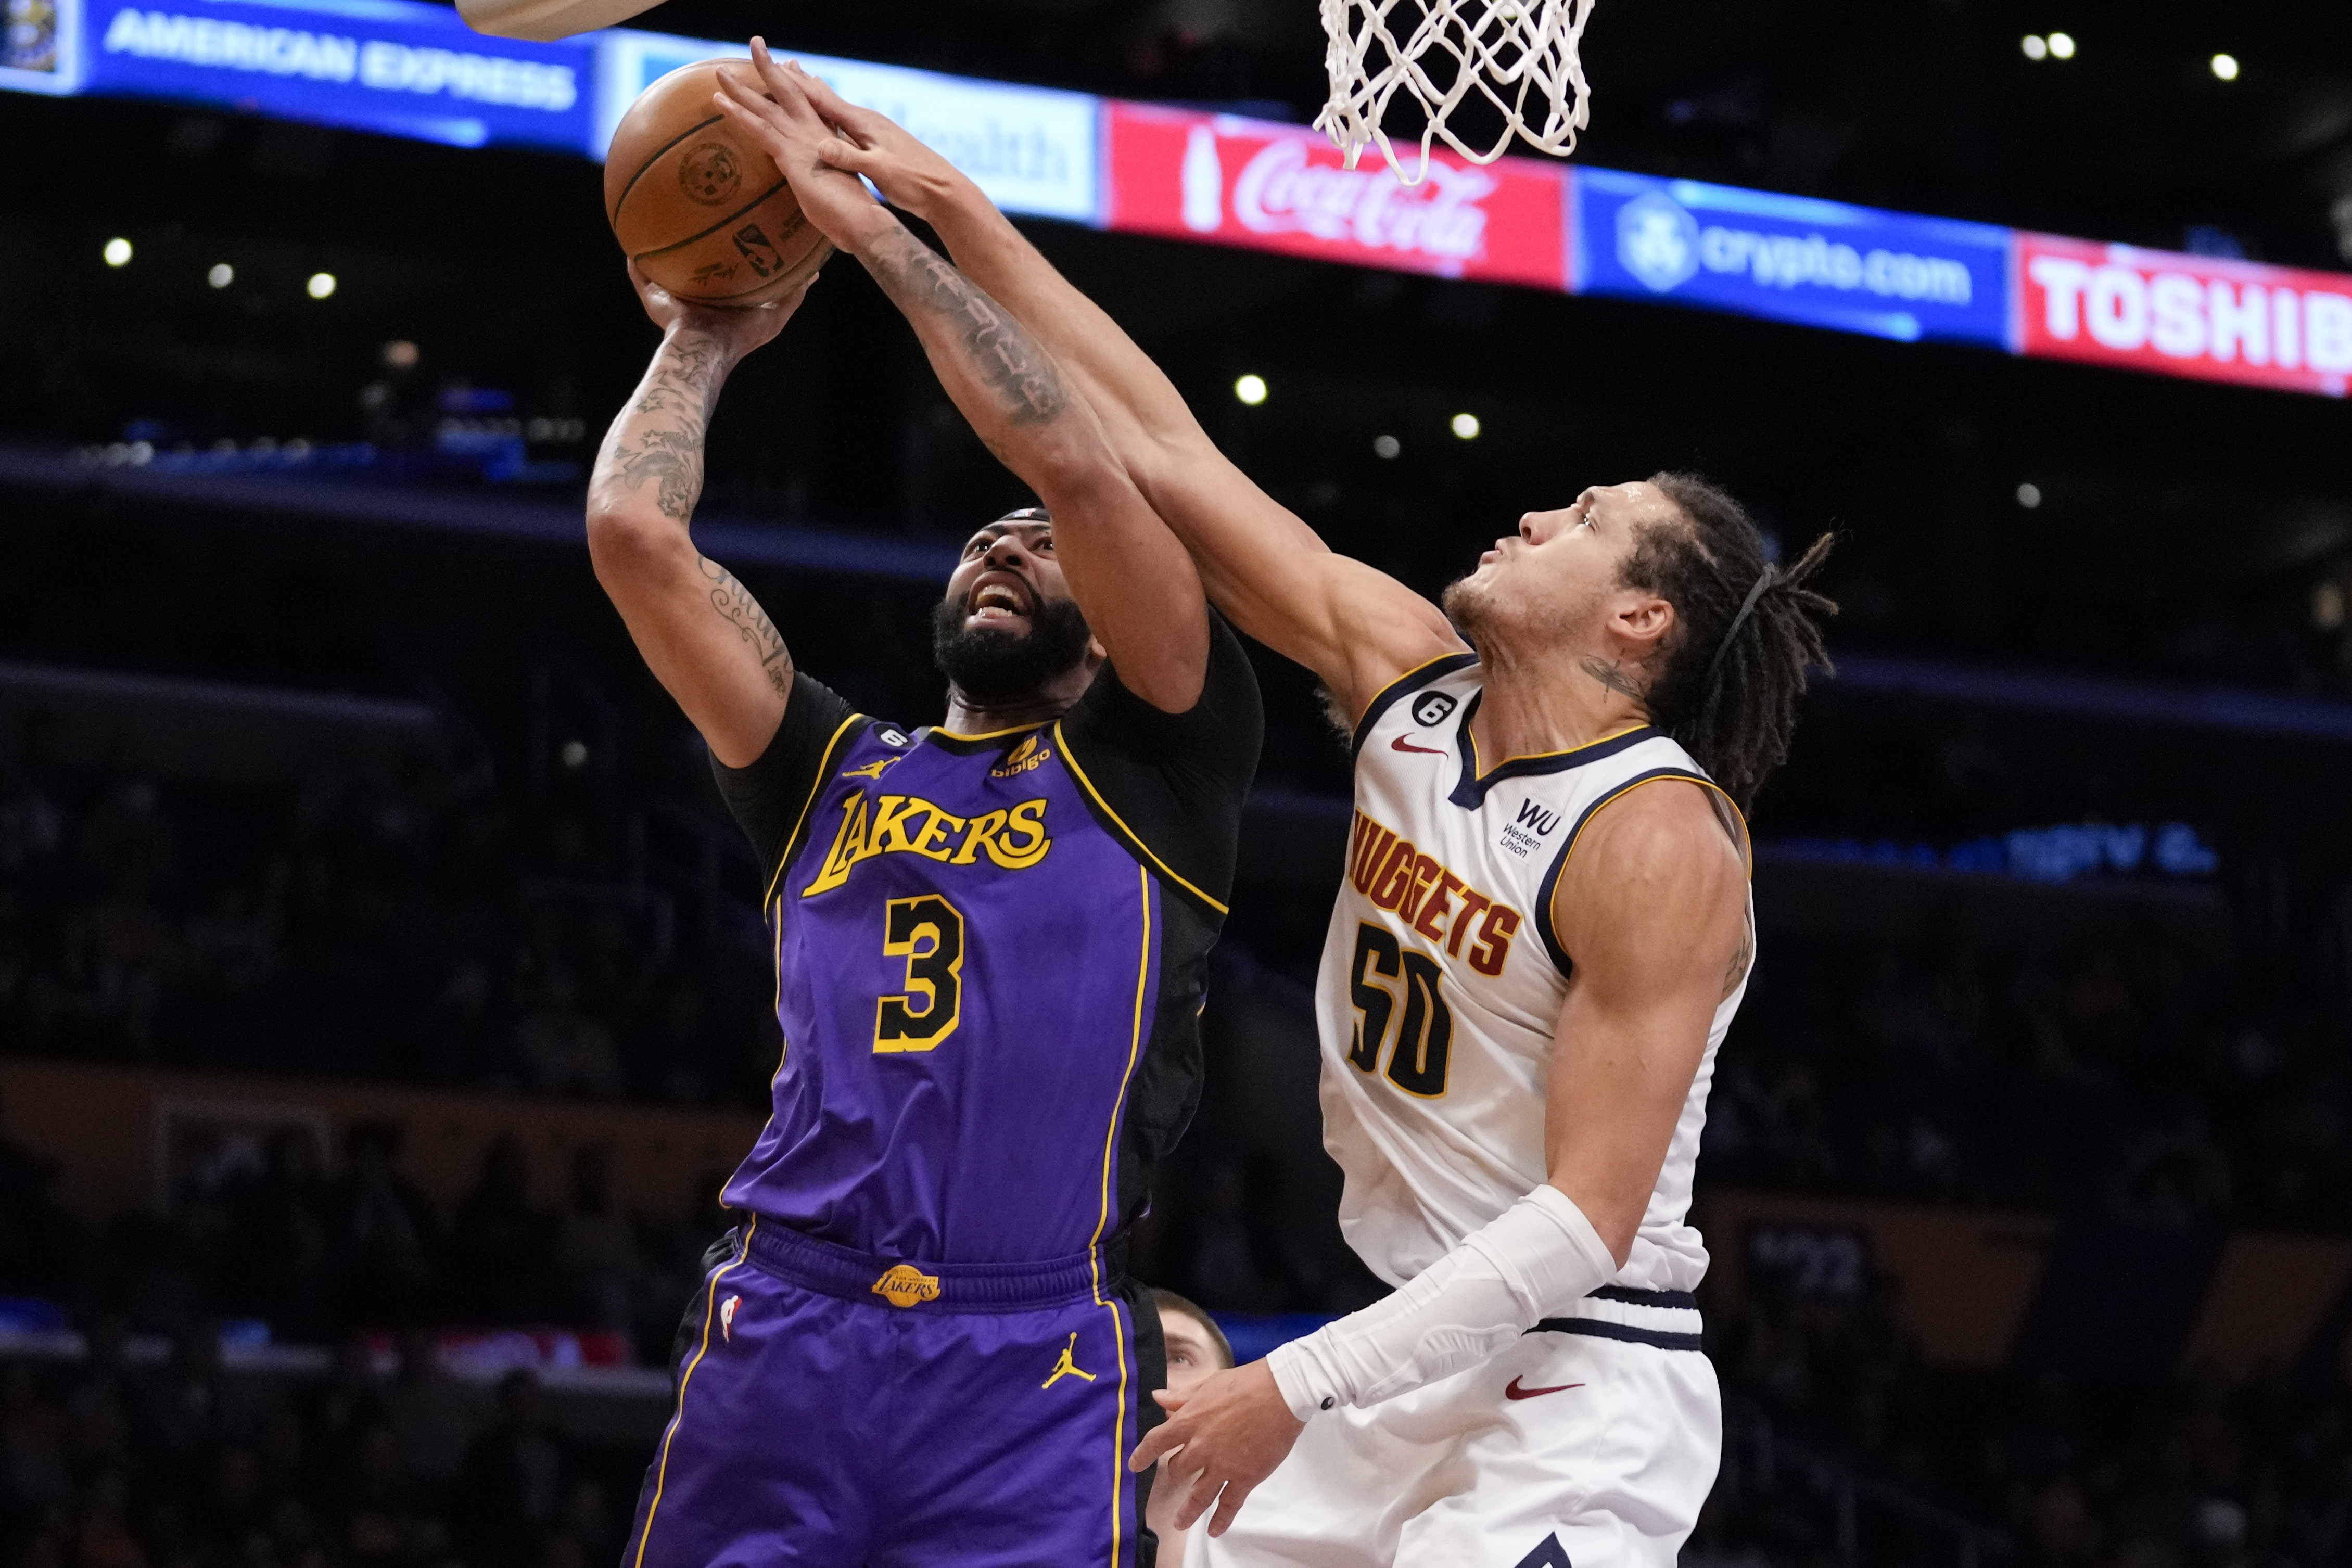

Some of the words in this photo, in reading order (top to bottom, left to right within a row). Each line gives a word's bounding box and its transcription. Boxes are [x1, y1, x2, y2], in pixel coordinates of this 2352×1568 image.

[104, 9, 358, 83] AMERICAN
[359, 39, 577, 112] EXPRESS
[1700, 225, 1972, 306] crypto.com
[1418, 697, 1452, 725] 6
[991, 749, 1050, 777] bibigo
[800, 789, 1052, 899] LAKERS
[1503, 823, 1541, 851] Western
[1516, 797, 1562, 836] WU
[1500, 836, 1528, 858] Union
[1349, 807, 1524, 979] NUGGETS
[873, 893, 964, 1054] 3
[1348, 920, 1454, 1100] 50
[876, 1273, 938, 1299] LAKERS
